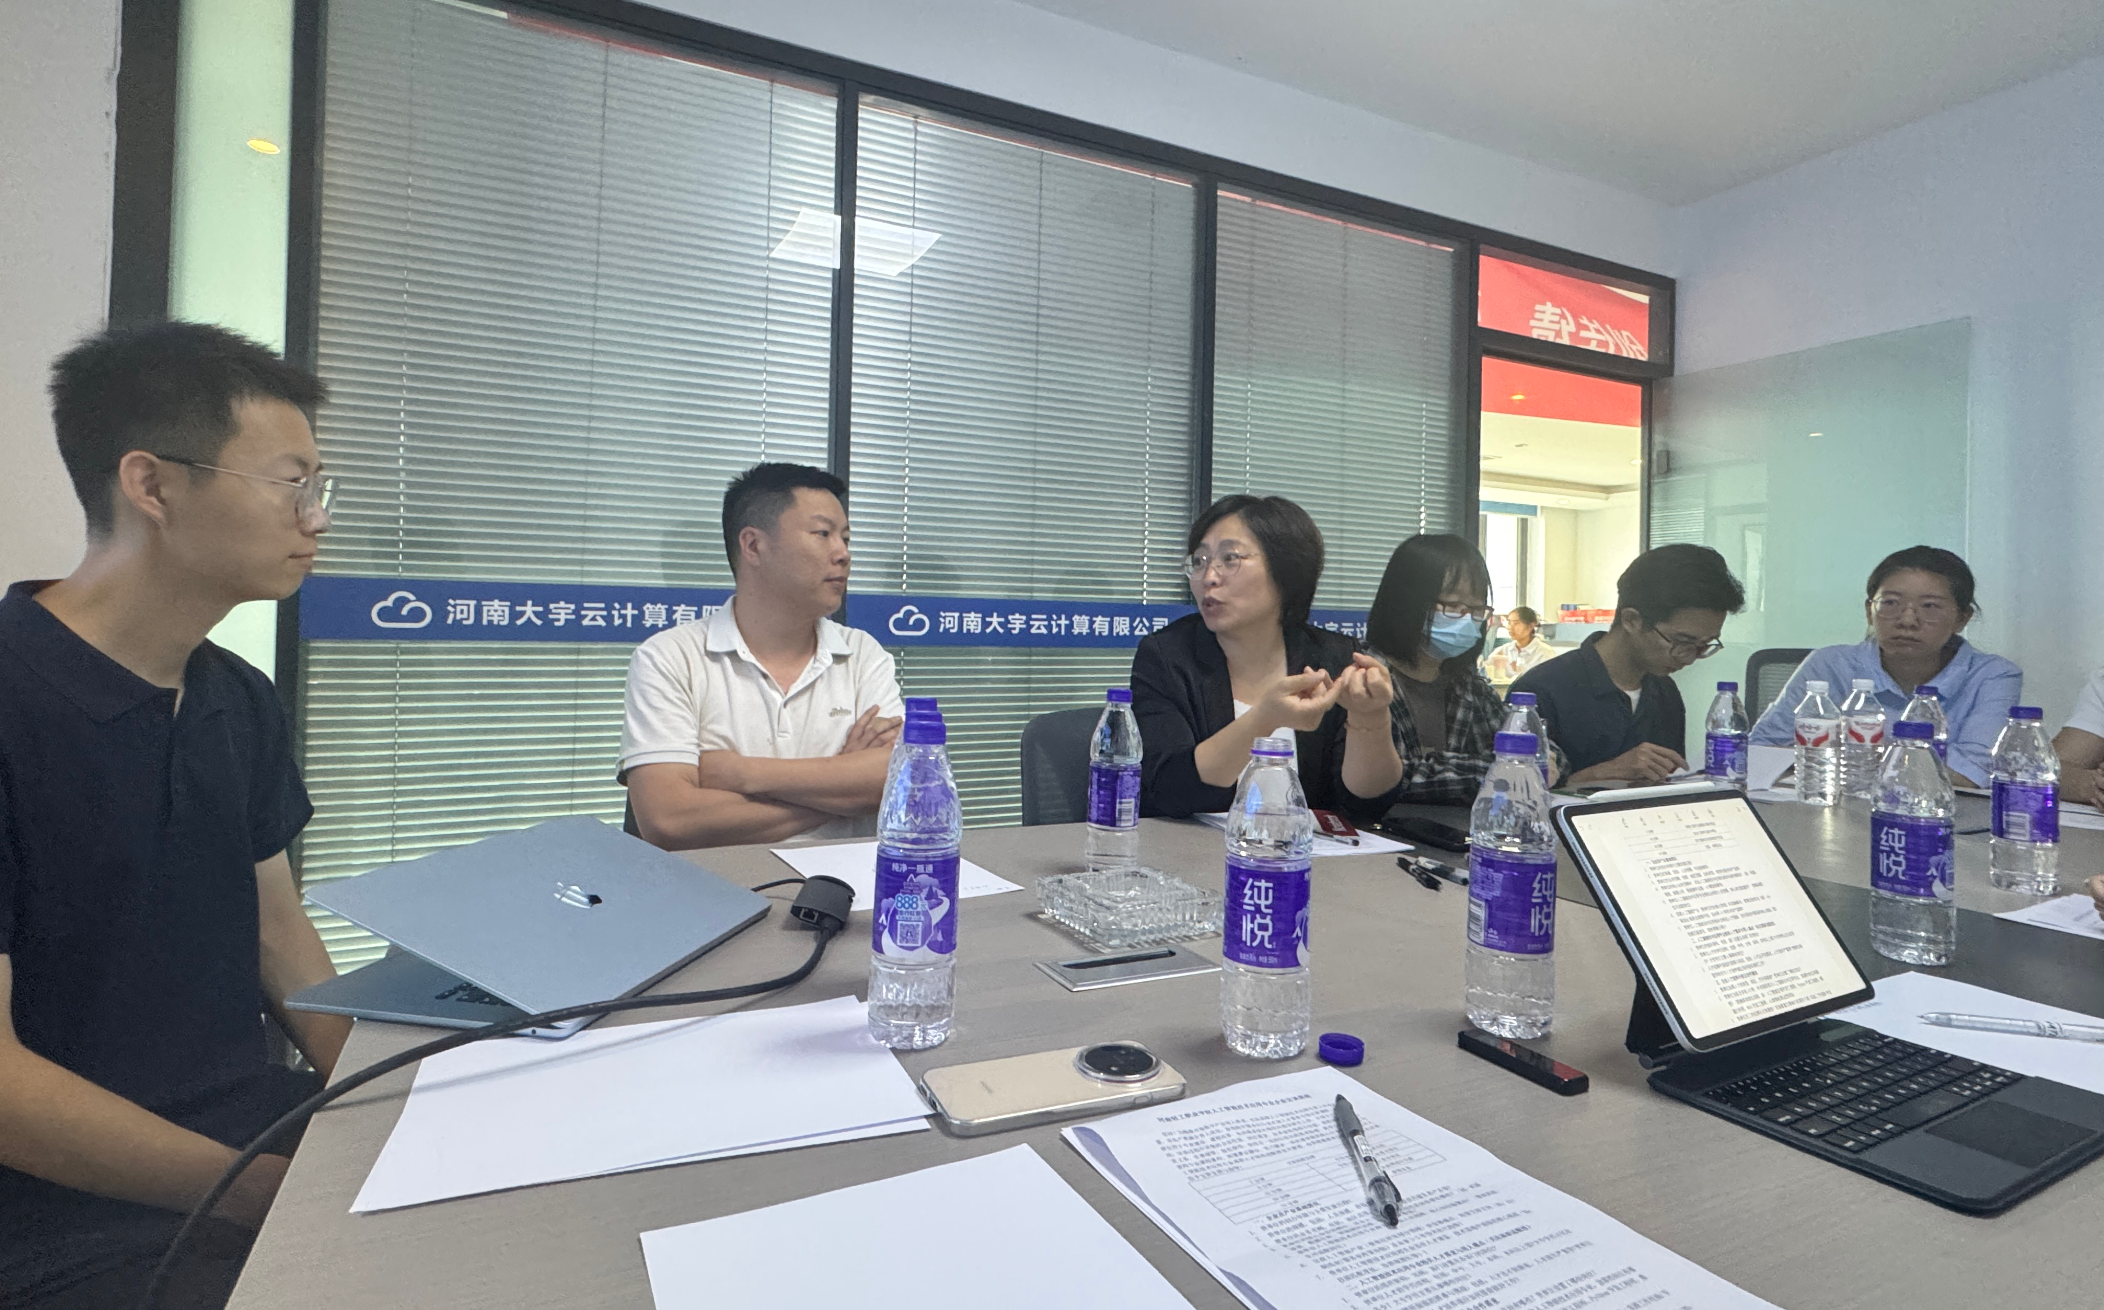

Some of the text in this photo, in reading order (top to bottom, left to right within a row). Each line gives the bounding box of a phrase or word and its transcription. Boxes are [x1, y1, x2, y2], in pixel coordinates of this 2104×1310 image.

[938, 611, 1169, 637] 河南大宇云计算有限公司
[1880, 826, 1907, 880] 纯悦
[1242, 877, 1274, 949] 纯悦
[1530, 871, 1555, 936] 纯悦
